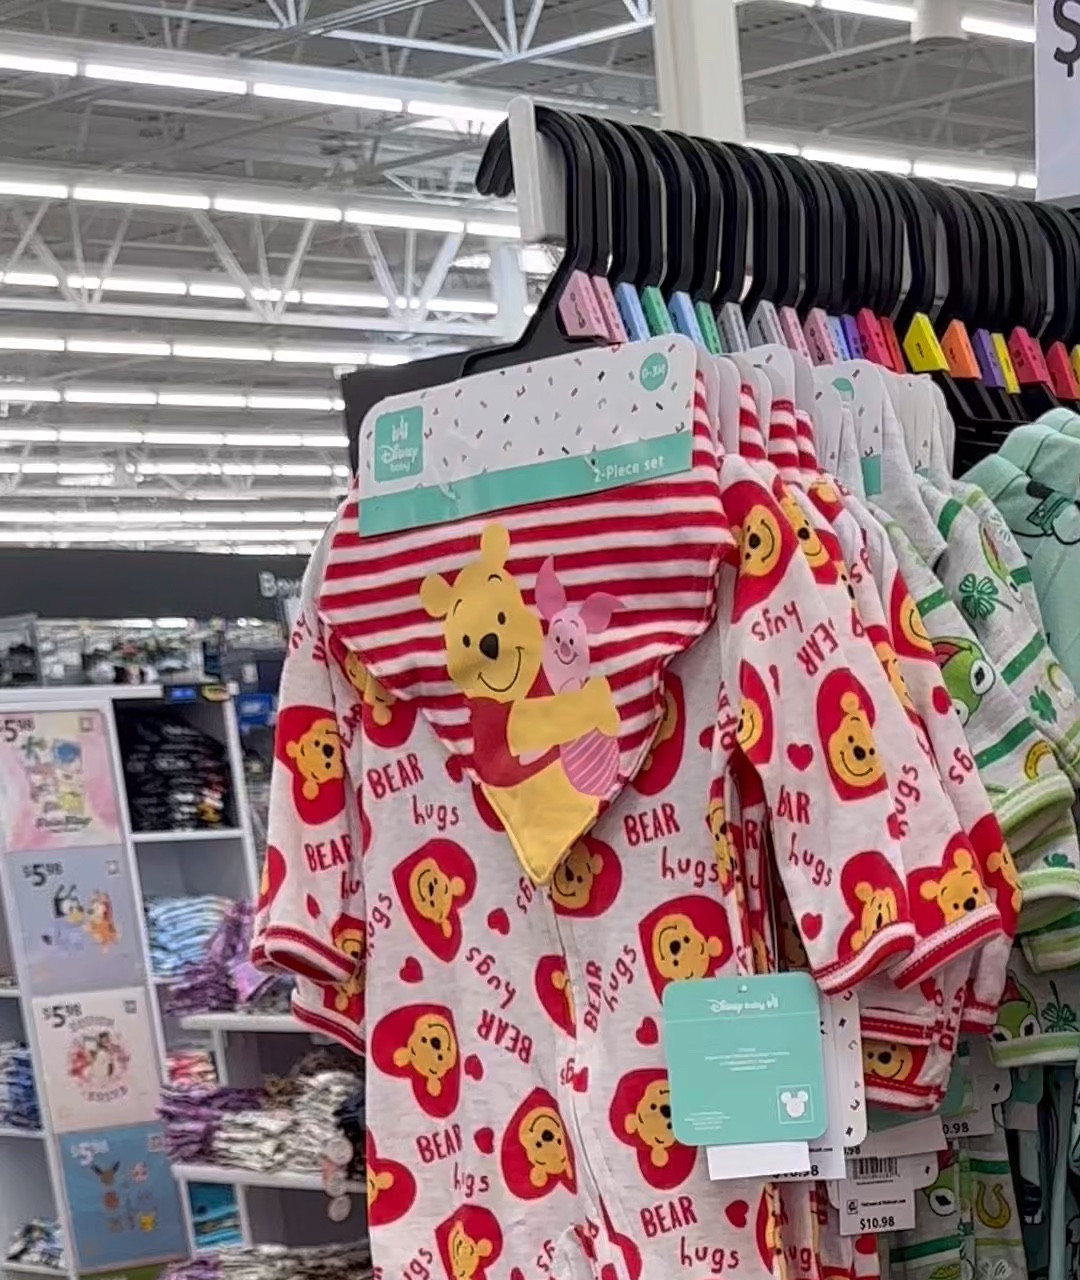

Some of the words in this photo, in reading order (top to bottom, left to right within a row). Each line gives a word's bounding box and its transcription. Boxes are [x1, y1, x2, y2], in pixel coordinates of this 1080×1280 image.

[380, 440, 419, 465] Disney
[594, 461, 641, 483] 2-Piece
[643, 455, 665, 473] set
[367, 752, 425, 800] BEAR
[412, 796, 461, 831] hugs
[623, 801, 682, 848] BEAR
[660, 847, 720, 889] hugs
[788, 831, 834, 887] hugs
[465, 946, 518, 1011] hugs
[584, 959, 604, 1034] BEAR
[602, 943, 638, 1014] hugs
[709, 1000, 744, 1015] Disney
[475, 1009, 535, 1064] BEAR
[415, 1122, 463, 1165] BEAR
[640, 1195, 698, 1239] BEAR
[859, 1215, 896, 1231] $10.98
[680, 1235, 741, 1275] hugs
